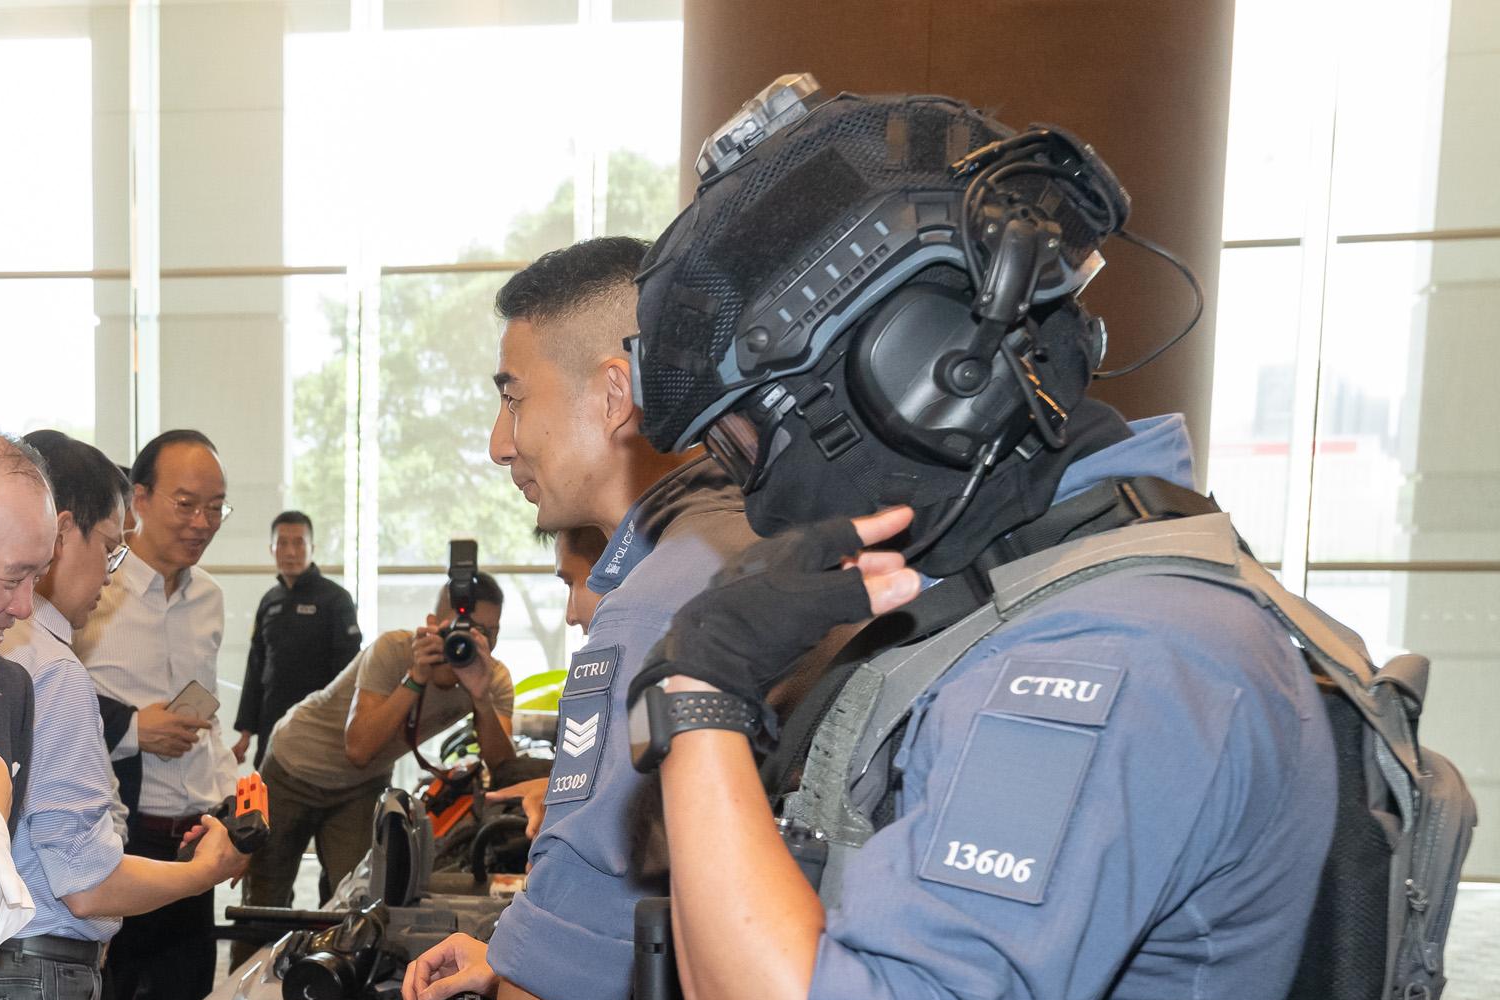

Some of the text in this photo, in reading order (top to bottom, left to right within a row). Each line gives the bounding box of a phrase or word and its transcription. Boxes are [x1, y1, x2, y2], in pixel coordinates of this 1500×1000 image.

[612, 530, 634, 564] POLICE
[574, 661, 610, 679] CTRU
[1009, 675, 1103, 702] CTRU
[553, 773, 588, 792] 33309
[943, 841, 1036, 883] 13606
